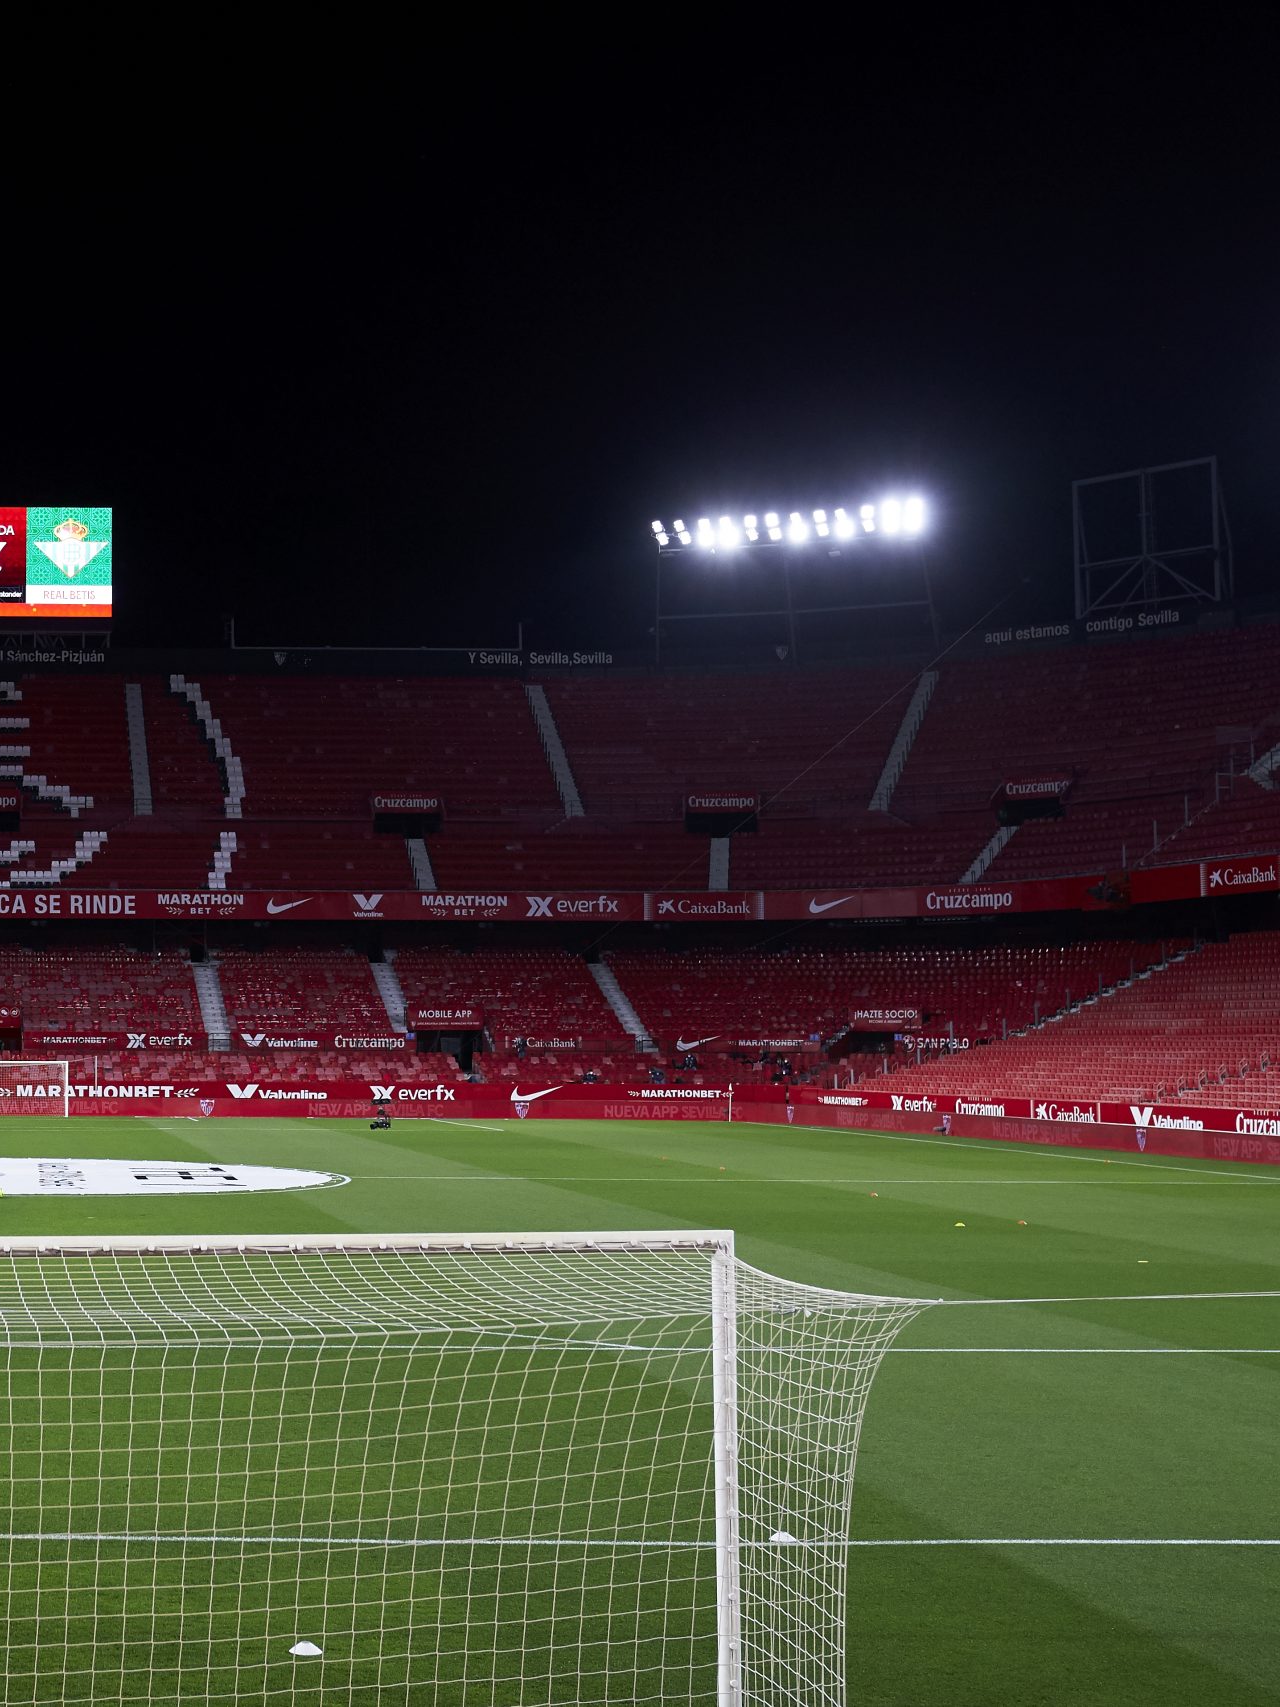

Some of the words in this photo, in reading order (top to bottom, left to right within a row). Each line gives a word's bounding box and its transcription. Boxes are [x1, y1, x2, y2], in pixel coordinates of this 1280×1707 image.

[44, 590, 67, 600] REAL
[69, 590, 96, 600] BETIS
[984, 628, 1012, 645] aquí
[1016, 624, 1070, 640] estamos
[1086, 616, 1132, 632] contigo
[1138, 610, 1180, 627] Sevilla
[7, 649, 104, 664] Sánchez-Pizjuán
[468, 652, 476, 664] Y
[480, 652, 523, 666] Sevilla,
[1006, 780, 1069, 795] Cruzcampo
[374, 796, 438, 809] Cruzcampo
[688, 796, 754, 809] Cruzcampo
[1224, 866, 1276, 886] CaixaBank
[34, 894, 60, 914] SE
[70, 895, 136, 914] RINDE
[158, 894, 244, 906] MARATHON
[422, 896, 508, 906] MARATHON
[556, 896, 618, 912] everfx
[926, 891, 1012, 910] Cruzcampo
[454, 908, 475, 916] BET
[678, 900, 750, 914] CaixaBank
[418, 1010, 452, 1018] MOBILE
[454, 1010, 472, 1018] APP
[854, 1010, 882, 1020] ¡HAZTE
[885, 1010, 918, 1019] SOCIO!
[150, 1033, 192, 1046] everfx
[266, 1038, 318, 1048] Valvoline
[334, 1035, 405, 1050] Cruzcampo
[526, 1037, 576, 1048] CaixaBank
[917, 1038, 938, 1049] SAN
[16, 1085, 174, 1098] MARATHONBET
[258, 1090, 328, 1100] Valvoline
[398, 1085, 455, 1100] everfx
[641, 1090, 721, 1098] MARATHONBET
[20, 1101, 48, 1114] APP
[102, 1102, 118, 1114] FC
[824, 1096, 862, 1106] MARATHONBET
[904, 1096, 932, 1112] everfx
[956, 1098, 1004, 1117] Cruzcampo
[308, 1104, 342, 1116] NEW
[344, 1104, 370, 1116] APP
[426, 1104, 444, 1116] FC
[604, 1105, 650, 1118] NUEVA
[652, 1105, 678, 1118] APP
[682, 1106, 728, 1118] SEVILLA
[1048, 1104, 1095, 1122] CaixaBank
[1236, 1112, 1280, 1136] Cruzca
[1240, 1139, 1262, 1158] APP
